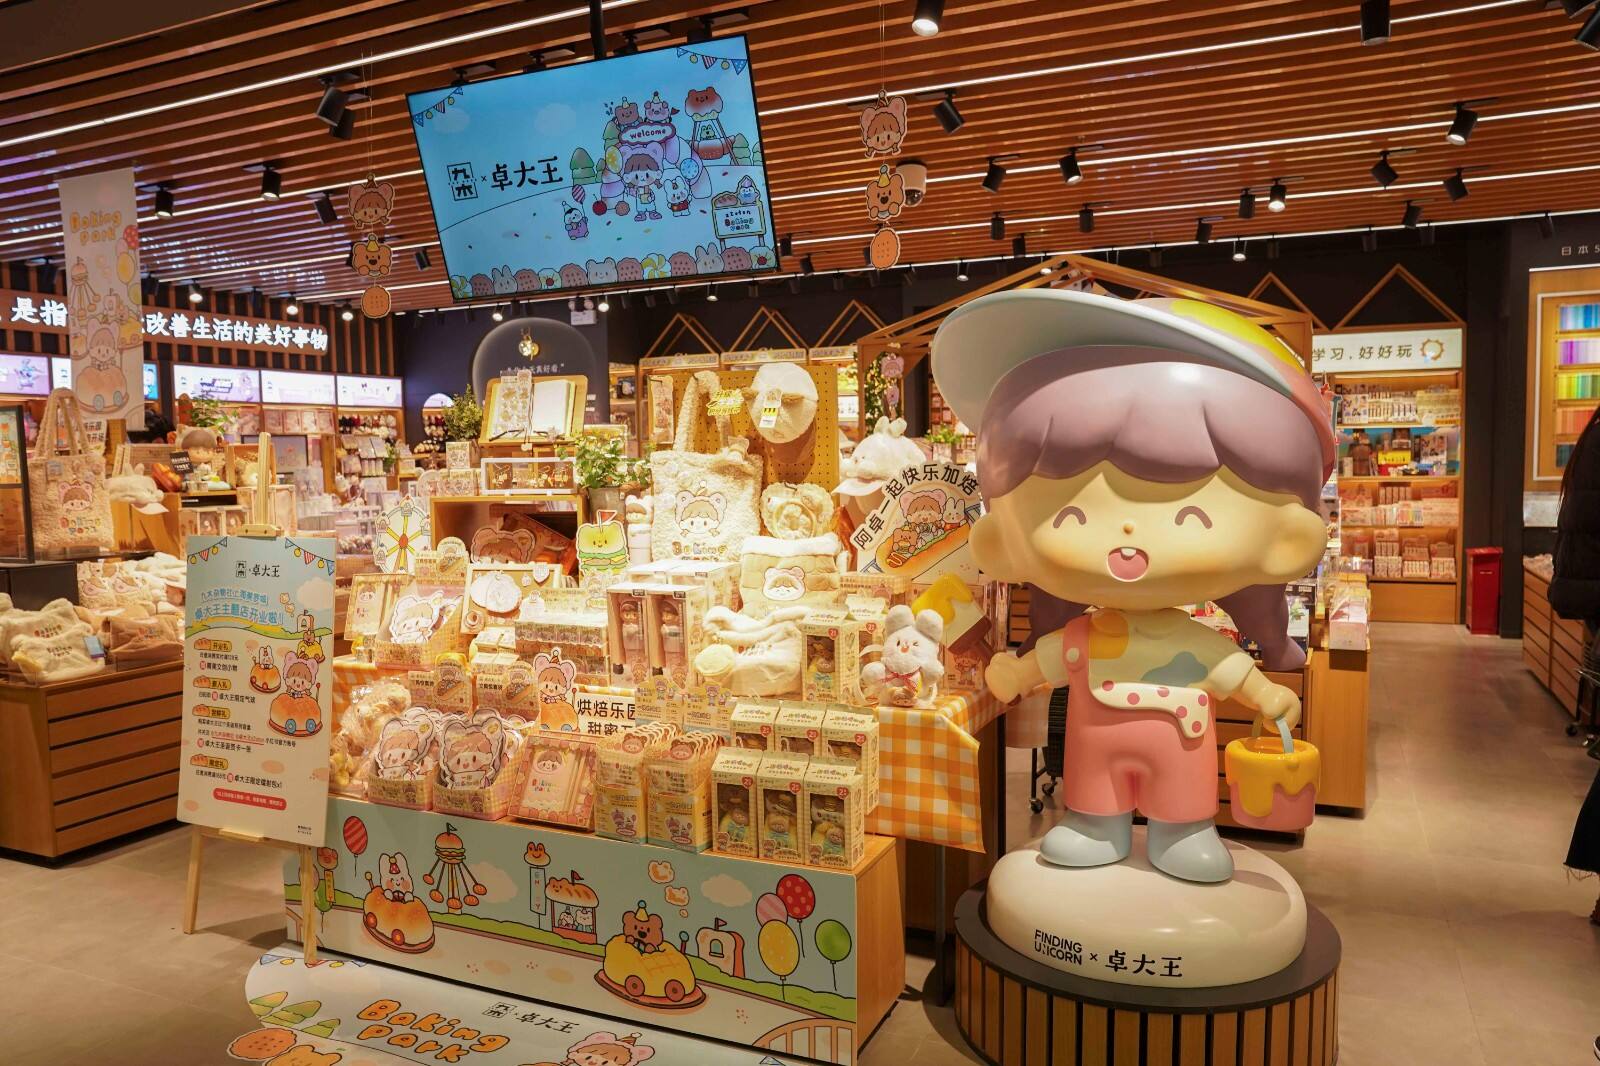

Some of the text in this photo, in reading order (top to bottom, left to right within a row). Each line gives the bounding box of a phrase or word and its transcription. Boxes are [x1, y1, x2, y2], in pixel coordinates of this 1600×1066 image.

[629, 129, 667, 139] welcome
[491, 156, 564, 191] 卓大王
[142, 312, 328, 351] 改善生活的美好事物
[853, 464, 979, 550] 阿卓一起快乐加焙
[588, 722, 633, 736] 甜蜜
[1034, 929, 1082, 953] FINDING
[1105, 949, 1182, 977] 卓大王
[356, 999, 510, 1053] Baking
[516, 1012, 581, 1034] 卓大王
